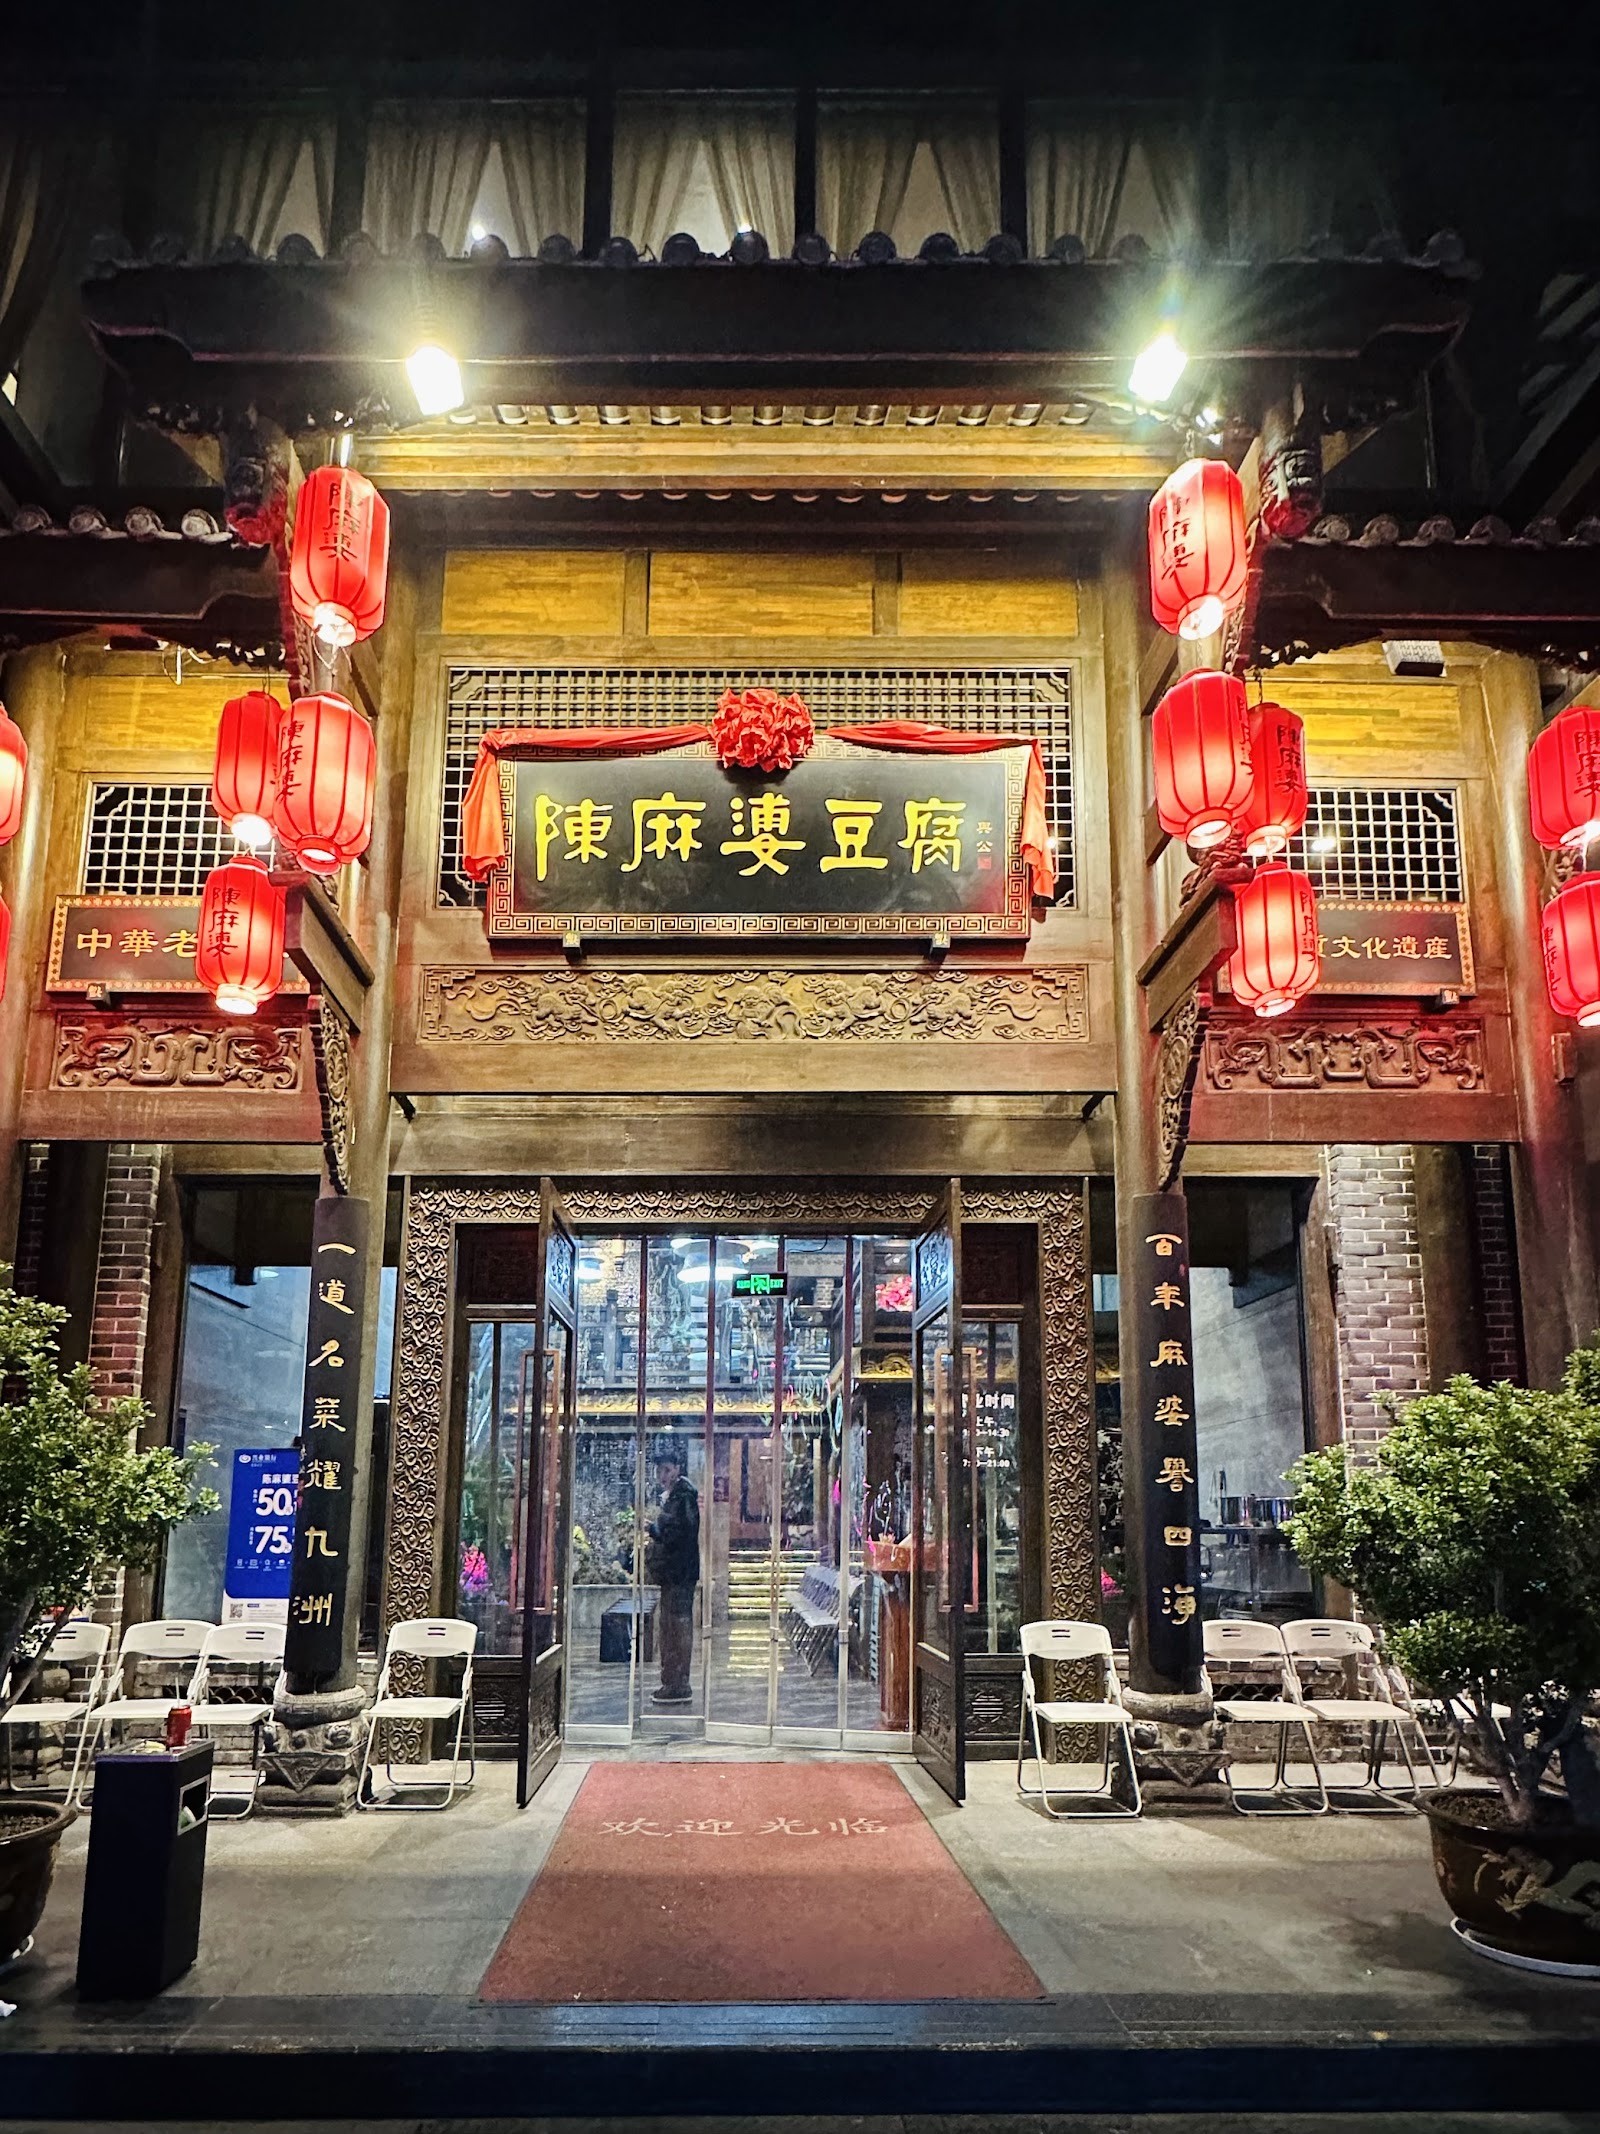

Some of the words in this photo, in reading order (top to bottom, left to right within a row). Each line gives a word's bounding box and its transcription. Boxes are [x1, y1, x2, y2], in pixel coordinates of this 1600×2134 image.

[534, 793, 967, 882] 陳麻婆豆腐
[975, 1416, 995, 1427] 上午
[975, 1446, 995, 1458] 下午
[599, 1816, 889, 1837] 欢迎光临
